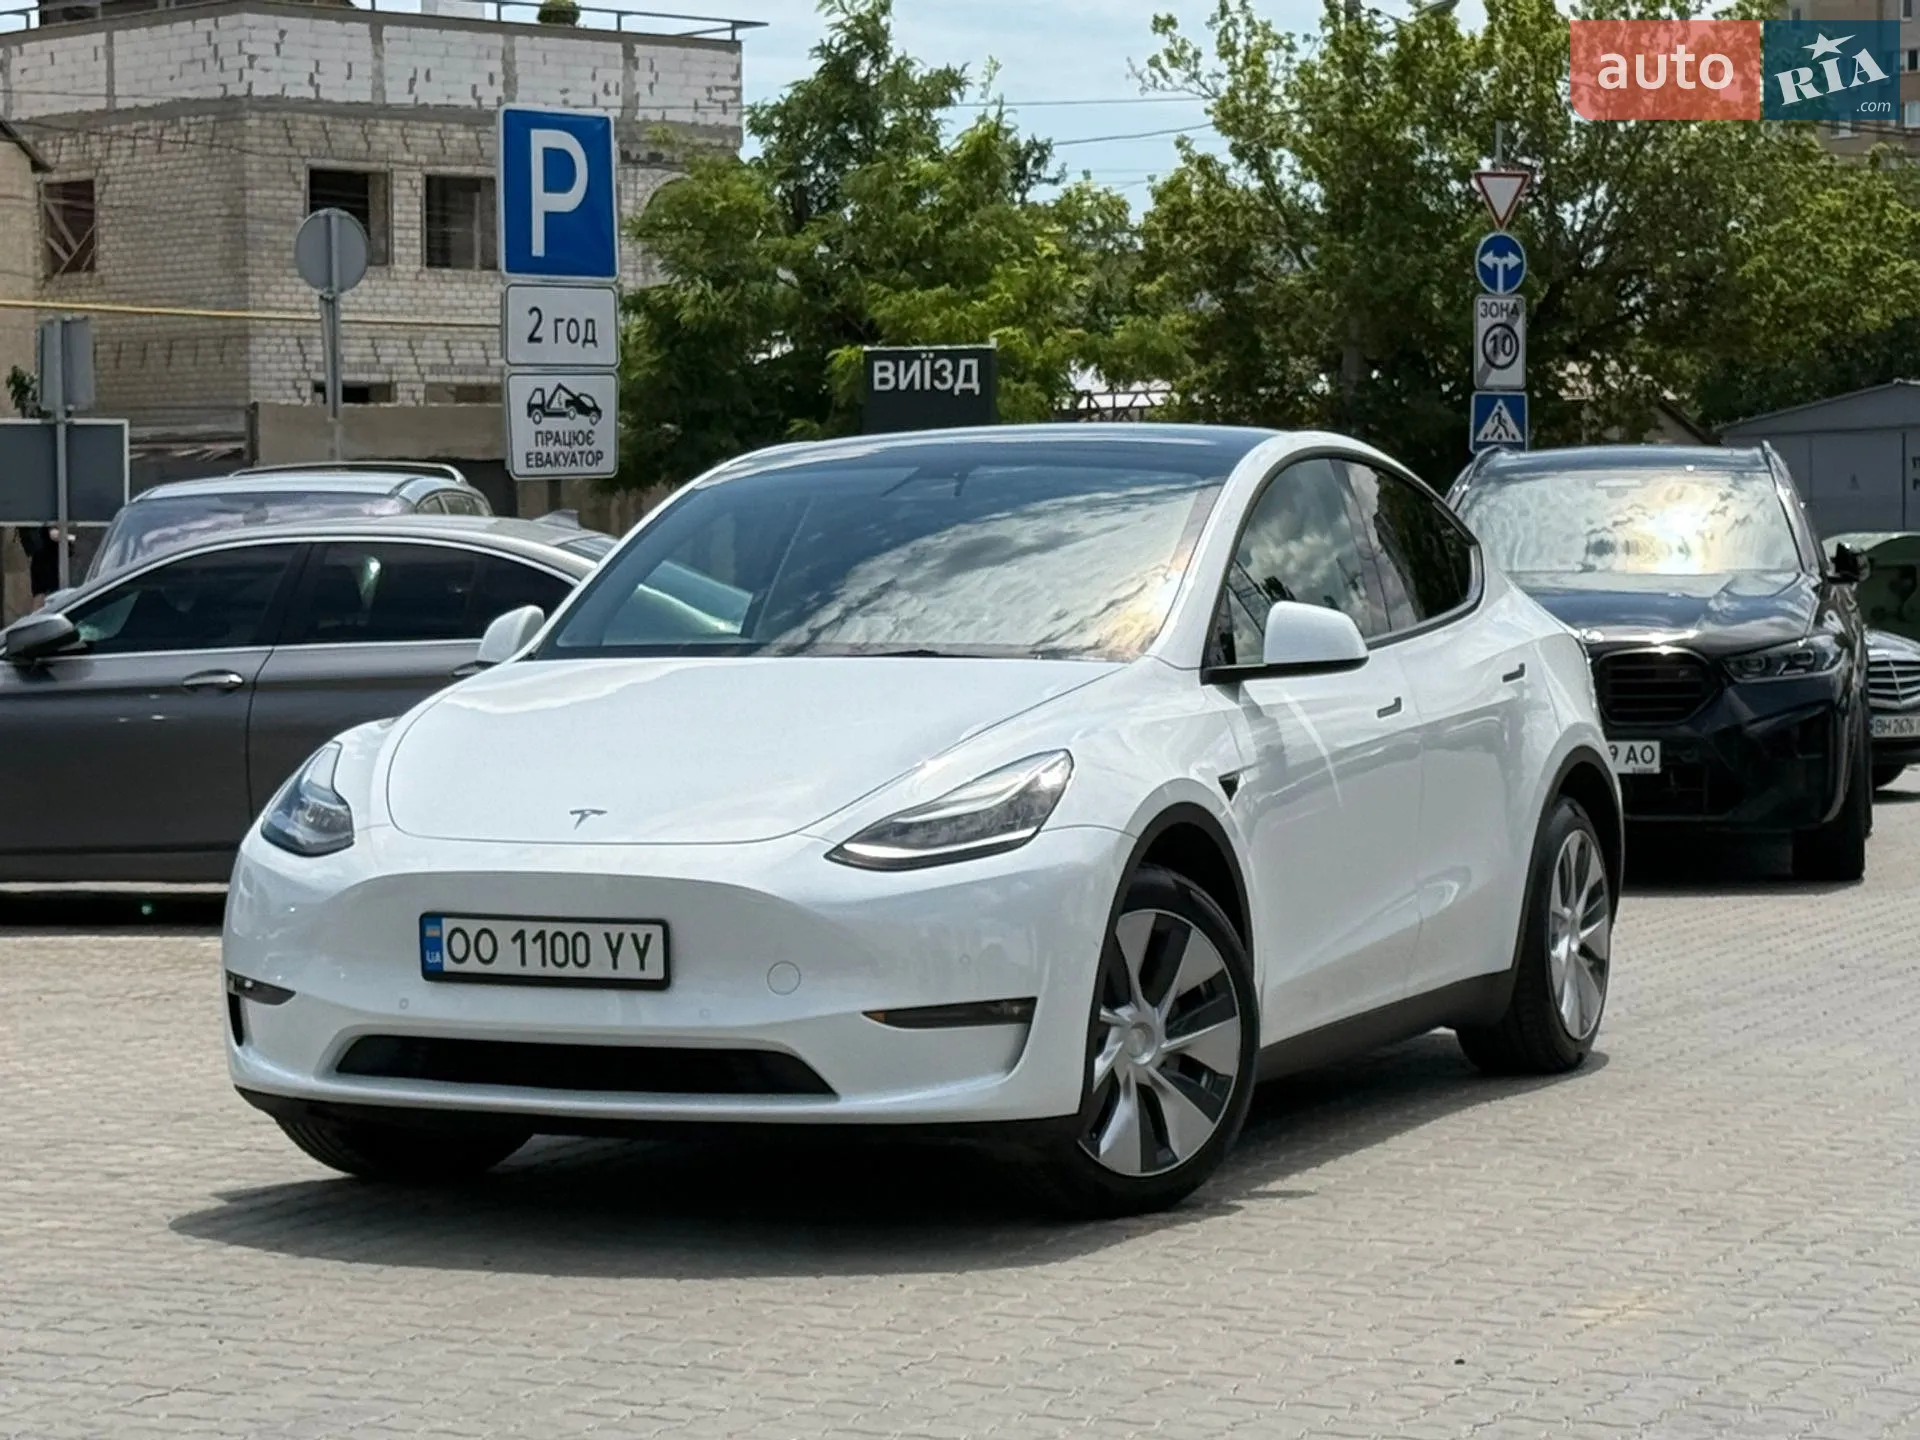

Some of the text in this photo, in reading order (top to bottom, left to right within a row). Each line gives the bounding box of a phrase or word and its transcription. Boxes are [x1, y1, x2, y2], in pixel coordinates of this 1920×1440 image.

[530, 128, 589, 257] P
[1480, 302, 1519, 318] ЗОНА
[527, 306, 598, 349] 2 год
[1489, 333, 1513, 357] 10
[873, 352, 980, 396] ВИЇЗД
[535, 430, 595, 448] ПРАЦЮЄ
[526, 450, 604, 468] ЕВАКУАТОР
[1625, 744, 1655, 765] AO
[447, 927, 653, 971] OO 1100 YY
